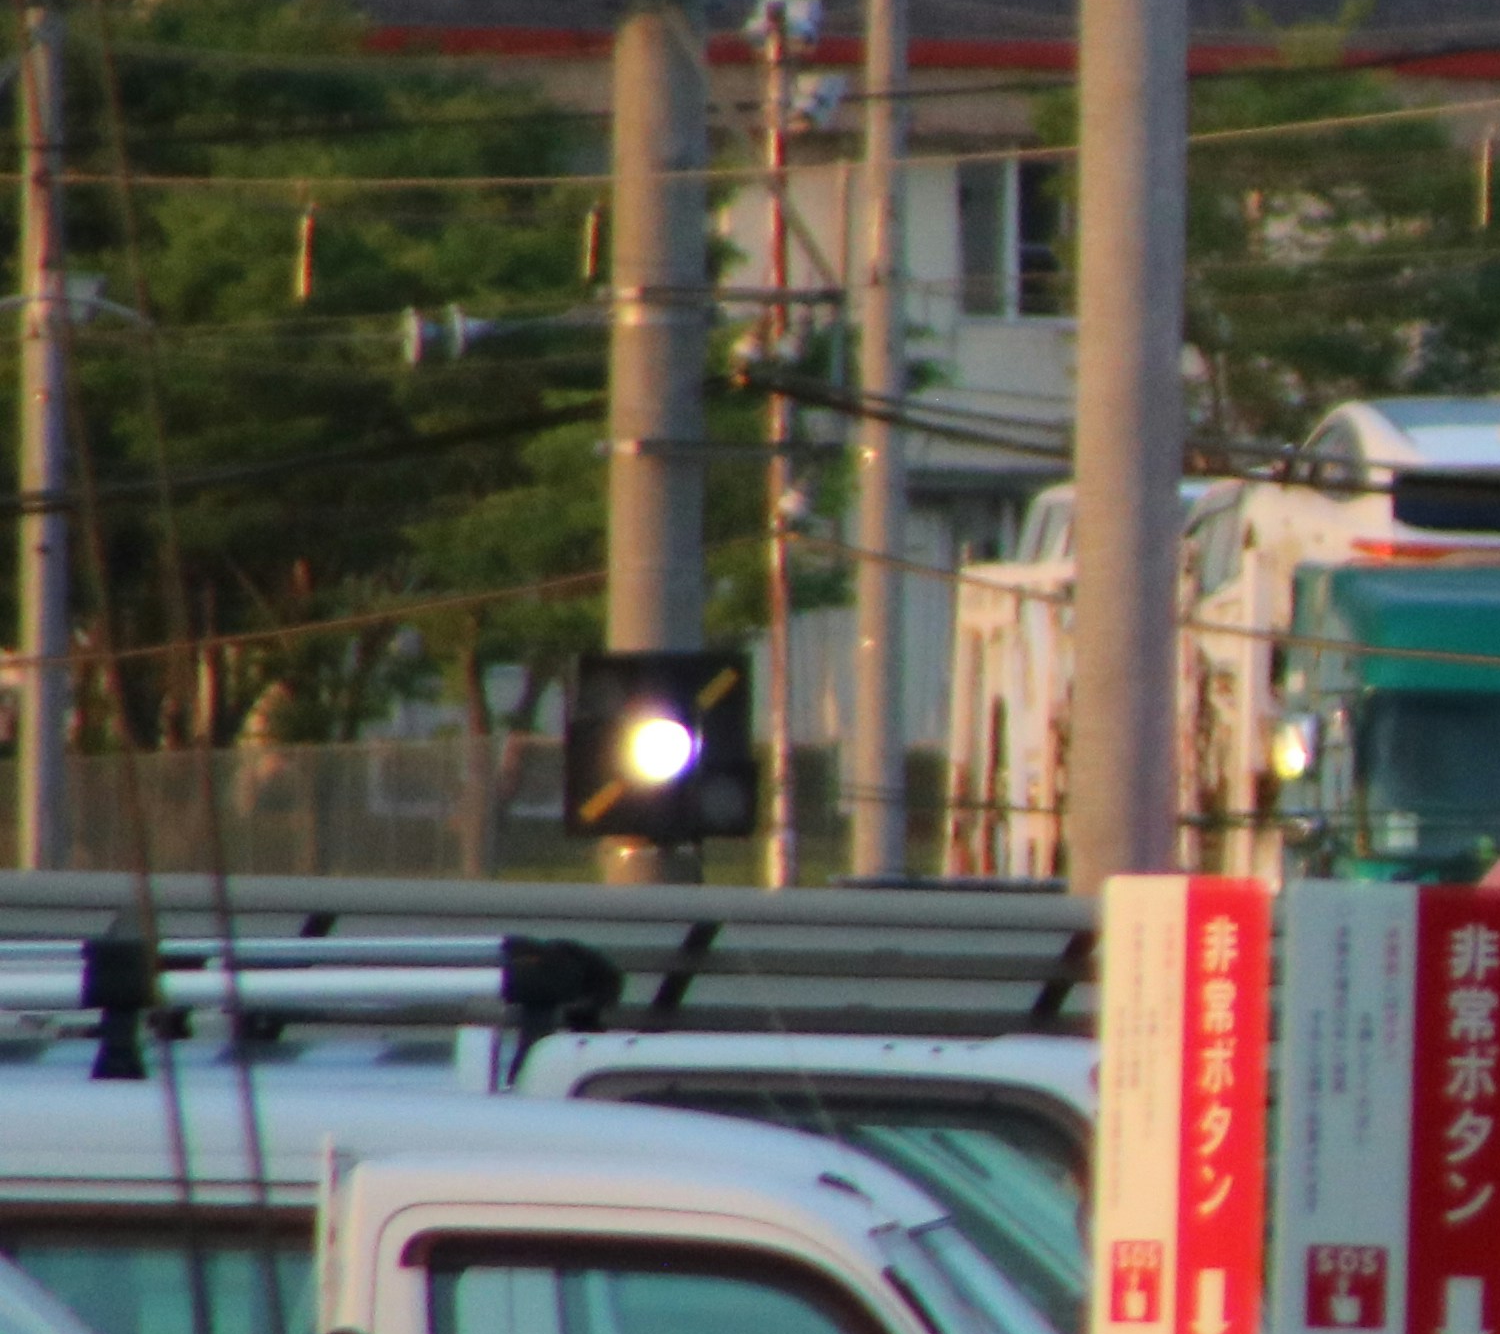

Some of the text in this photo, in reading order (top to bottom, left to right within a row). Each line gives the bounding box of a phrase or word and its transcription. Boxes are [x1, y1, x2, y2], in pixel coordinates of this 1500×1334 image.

[1199, 914, 1238, 1216] 非常ボタン
[1443, 923, 1500, 1223] 非常ボタン
[1315, 1248, 1377, 1274] SOS
